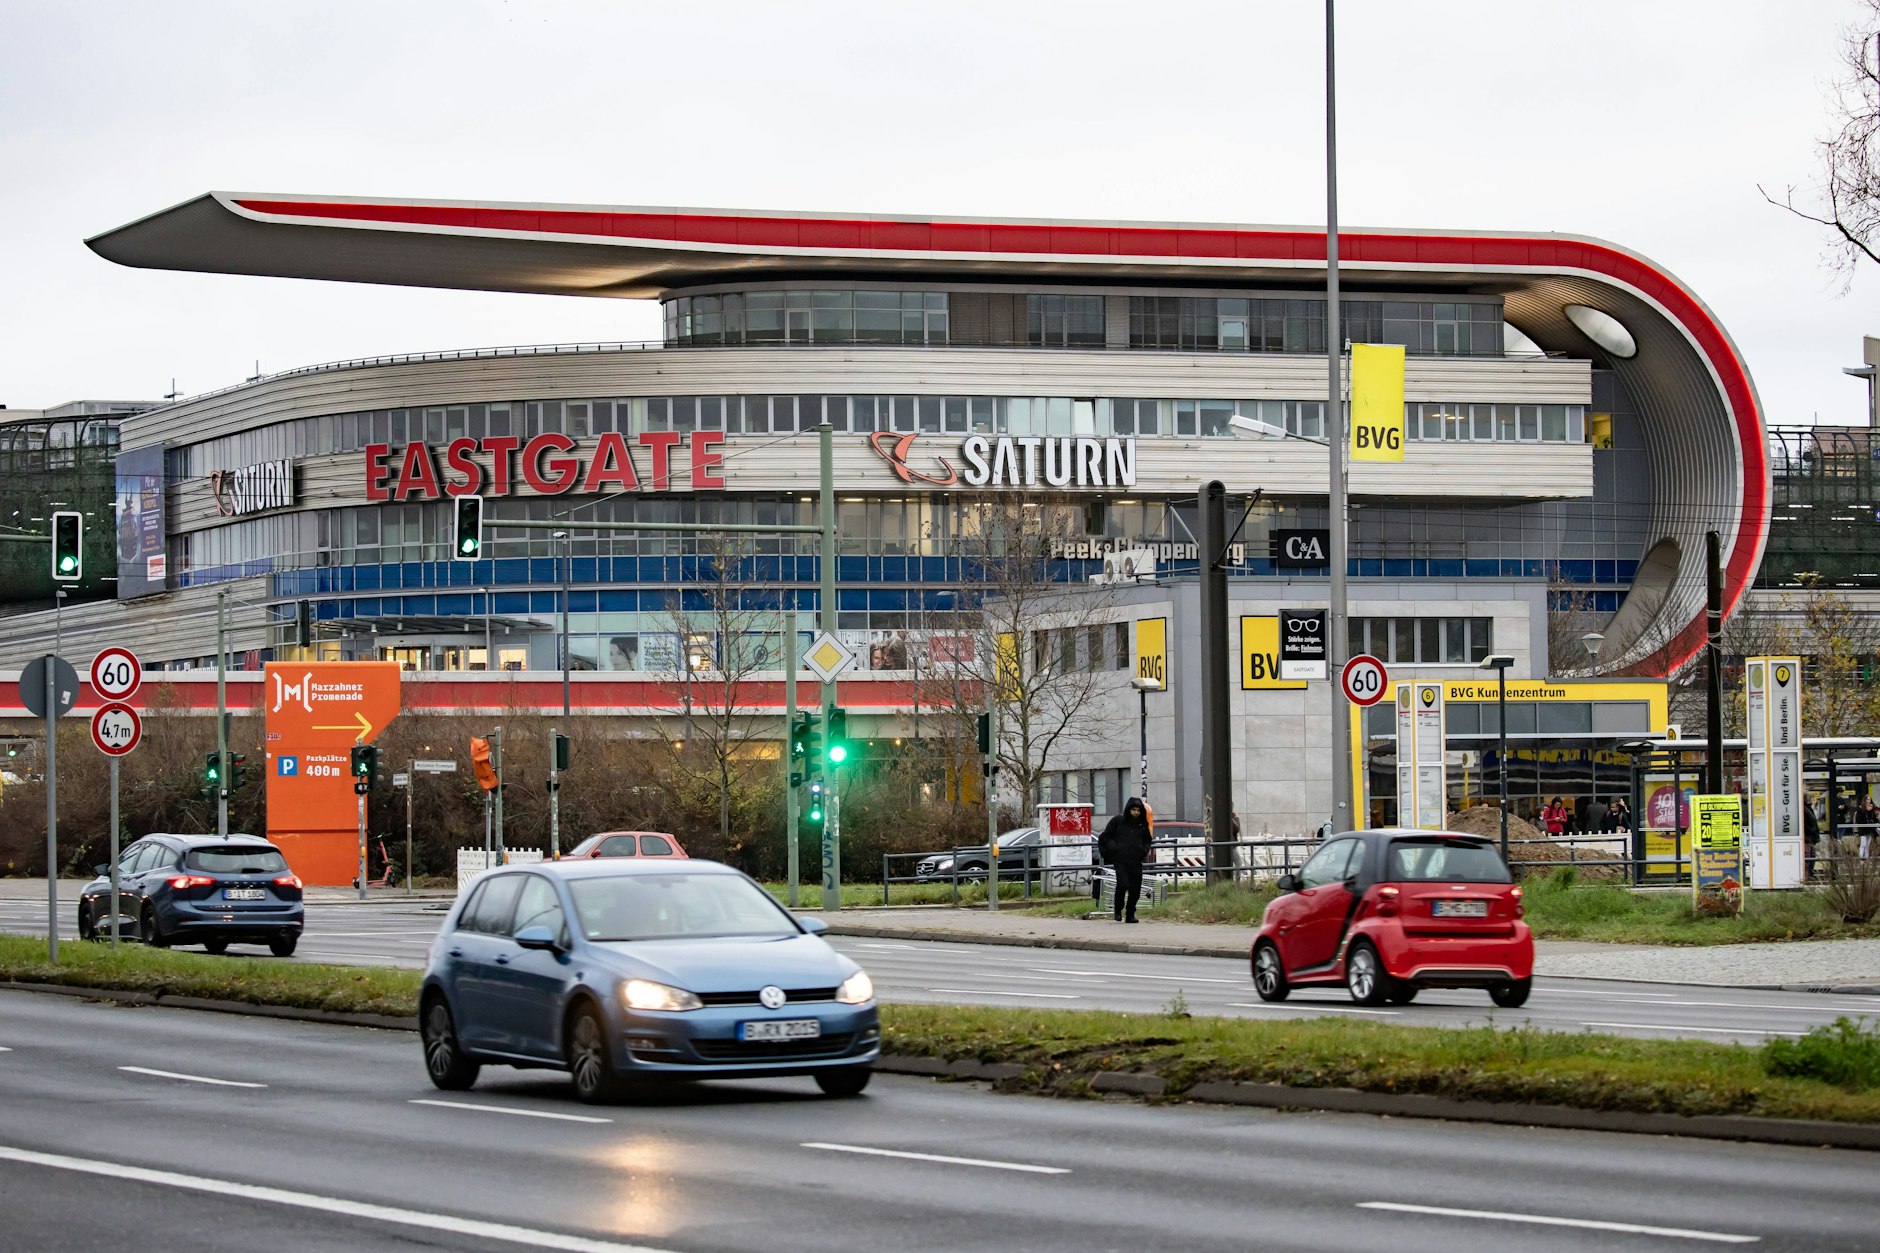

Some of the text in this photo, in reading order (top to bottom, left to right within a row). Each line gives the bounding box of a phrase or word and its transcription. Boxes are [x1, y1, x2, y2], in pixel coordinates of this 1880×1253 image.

[1356, 425, 1399, 450] BVG
[365, 431, 725, 501] EASTGATE
[963, 434, 1137, 487] SATURN
[234, 459, 290, 515] SATURN
[1285, 536, 1325, 560] C&A
[1285, 644, 1324, 652] Brille: Fielmann.
[1287, 635, 1321, 645] Stärke zeigen.
[102, 662, 130, 686] 60
[1140, 654, 1162, 682] BVG
[1780, 669, 1785, 679] 7
[311, 683, 363, 691] Marzahner
[1352, 669, 1378, 693] 60
[311, 692, 363, 701] Promenade
[1425, 692, 1431, 700] 6
[1451, 687, 1566, 698] BVG Kunenzentrum
[1780, 696, 1788, 744] Und Berlin.
[283, 758, 294, 775] P
[306, 755, 347, 763] Parkplätze
[1781, 755, 1789, 771] Sie.
[1781, 773, 1790, 788] für
[1782, 789, 1790, 805] Gut
[1782, 814, 1790, 833] BVG
[1701, 825, 1712, 839] 20
[746, 1024, 755, 1038] B
